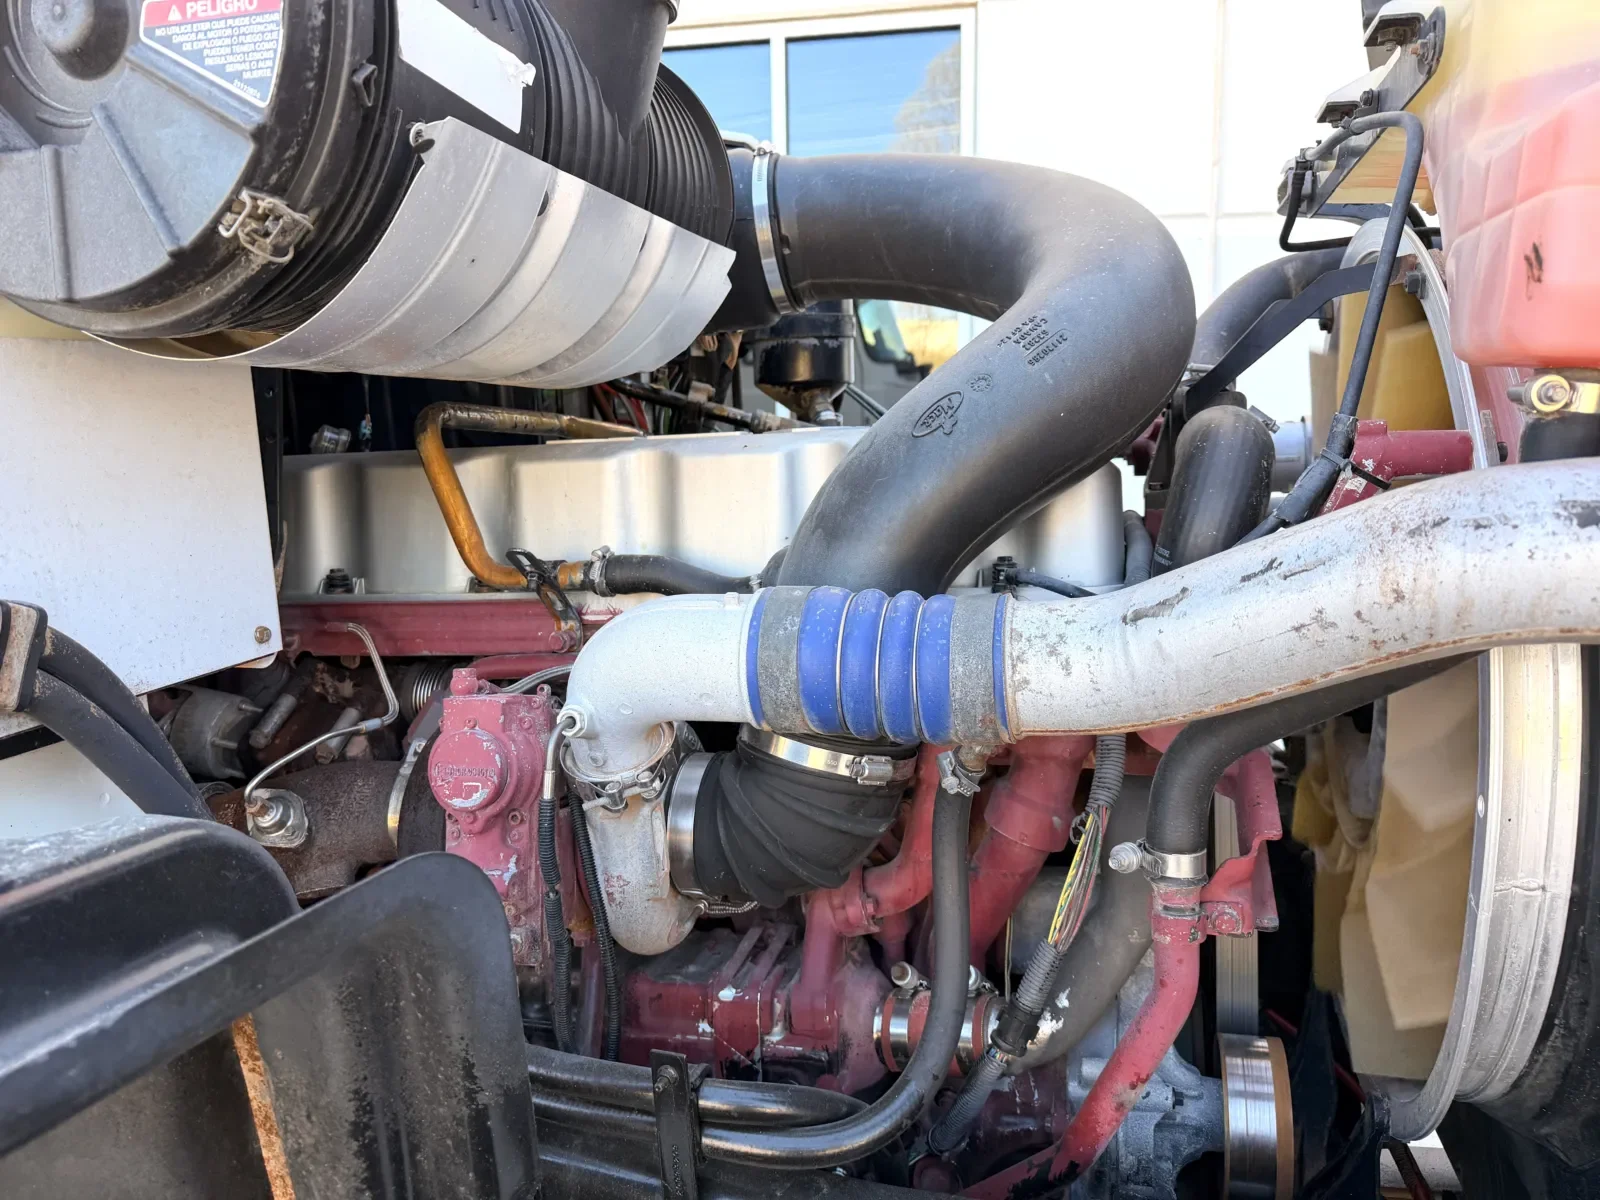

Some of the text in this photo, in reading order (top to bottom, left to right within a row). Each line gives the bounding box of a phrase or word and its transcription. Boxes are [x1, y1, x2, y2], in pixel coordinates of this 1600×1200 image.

[186, 0, 257, 19] PELIGRO
[155, 28, 166, 37] NO
[211, 20, 226, 30] QUE
[227, 16, 249, 27] PUEDE
[251, 12, 279, 24] CAUSAR
[197, 31, 207, 40] AL
[207, 27, 232, 39] MOTOR
[233, 27, 239, 35] O
[182, 41, 192, 50] DE
[232, 36, 238, 44] O
[239, 32, 262, 43] FUEGO
[263, 30, 278, 40] QUE
[255, 40, 277, 51] COMO
[251, 61, 257, 69] O
[1013, 318, 1048, 344] CANADA
